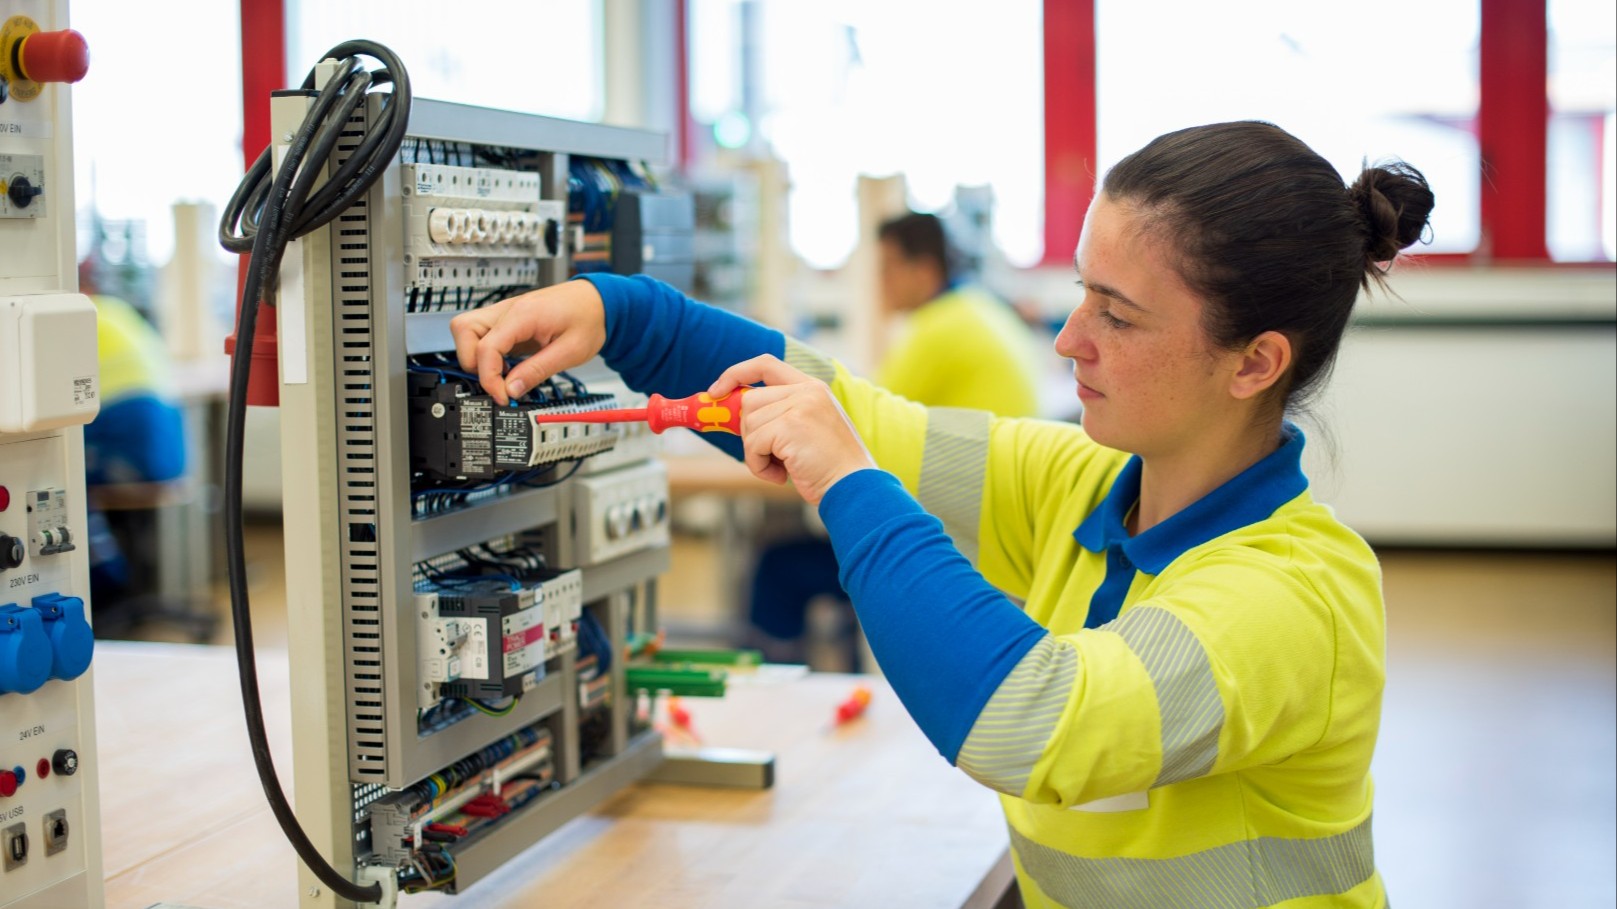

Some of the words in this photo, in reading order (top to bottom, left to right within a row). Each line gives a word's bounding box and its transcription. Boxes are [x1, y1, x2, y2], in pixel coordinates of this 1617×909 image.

[10, 576, 26, 588] 230V
[27, 573, 39, 584] EIN
[19, 728, 32, 741] 24V
[33, 724, 45, 736] EIN
[9, 805, 24, 819] USB
